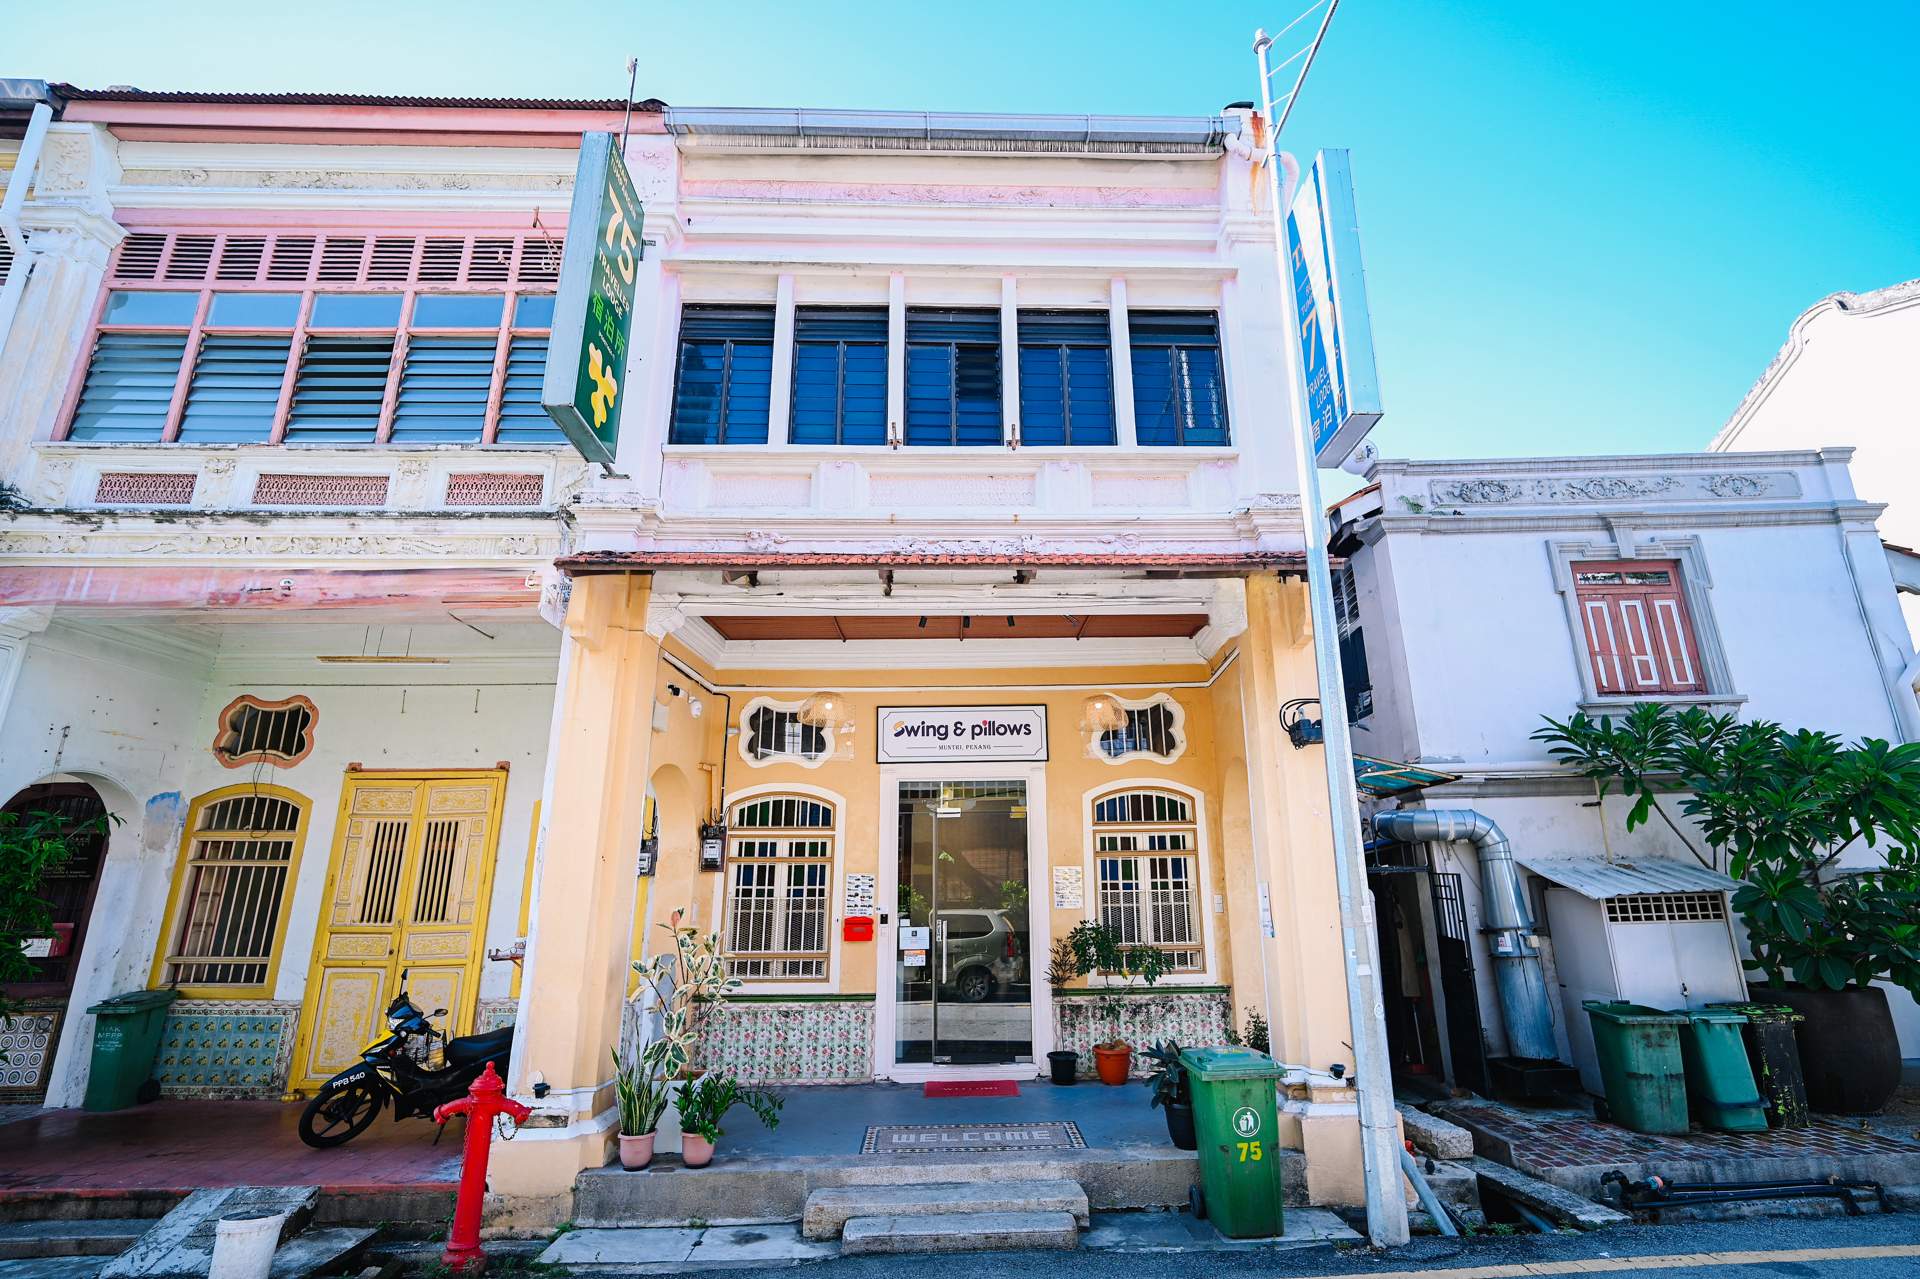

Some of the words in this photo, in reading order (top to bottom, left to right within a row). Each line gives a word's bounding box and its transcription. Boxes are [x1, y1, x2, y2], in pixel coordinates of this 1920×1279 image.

[605, 181, 637, 285] 75
[599, 247, 630, 315] TRAVELLER
[602, 275, 622, 320] LODGE
[592, 289, 625, 361] 宿泊所
[894, 720, 949, 741] Swing
[953, 721, 966, 737] &
[971, 720, 1032, 741] pillows
[332, 1076, 350, 1089] PPB
[349, 1071, 366, 1083] 540
[892, 1130, 1051, 1143] WELCOME
[1236, 1140, 1263, 1162] 75
